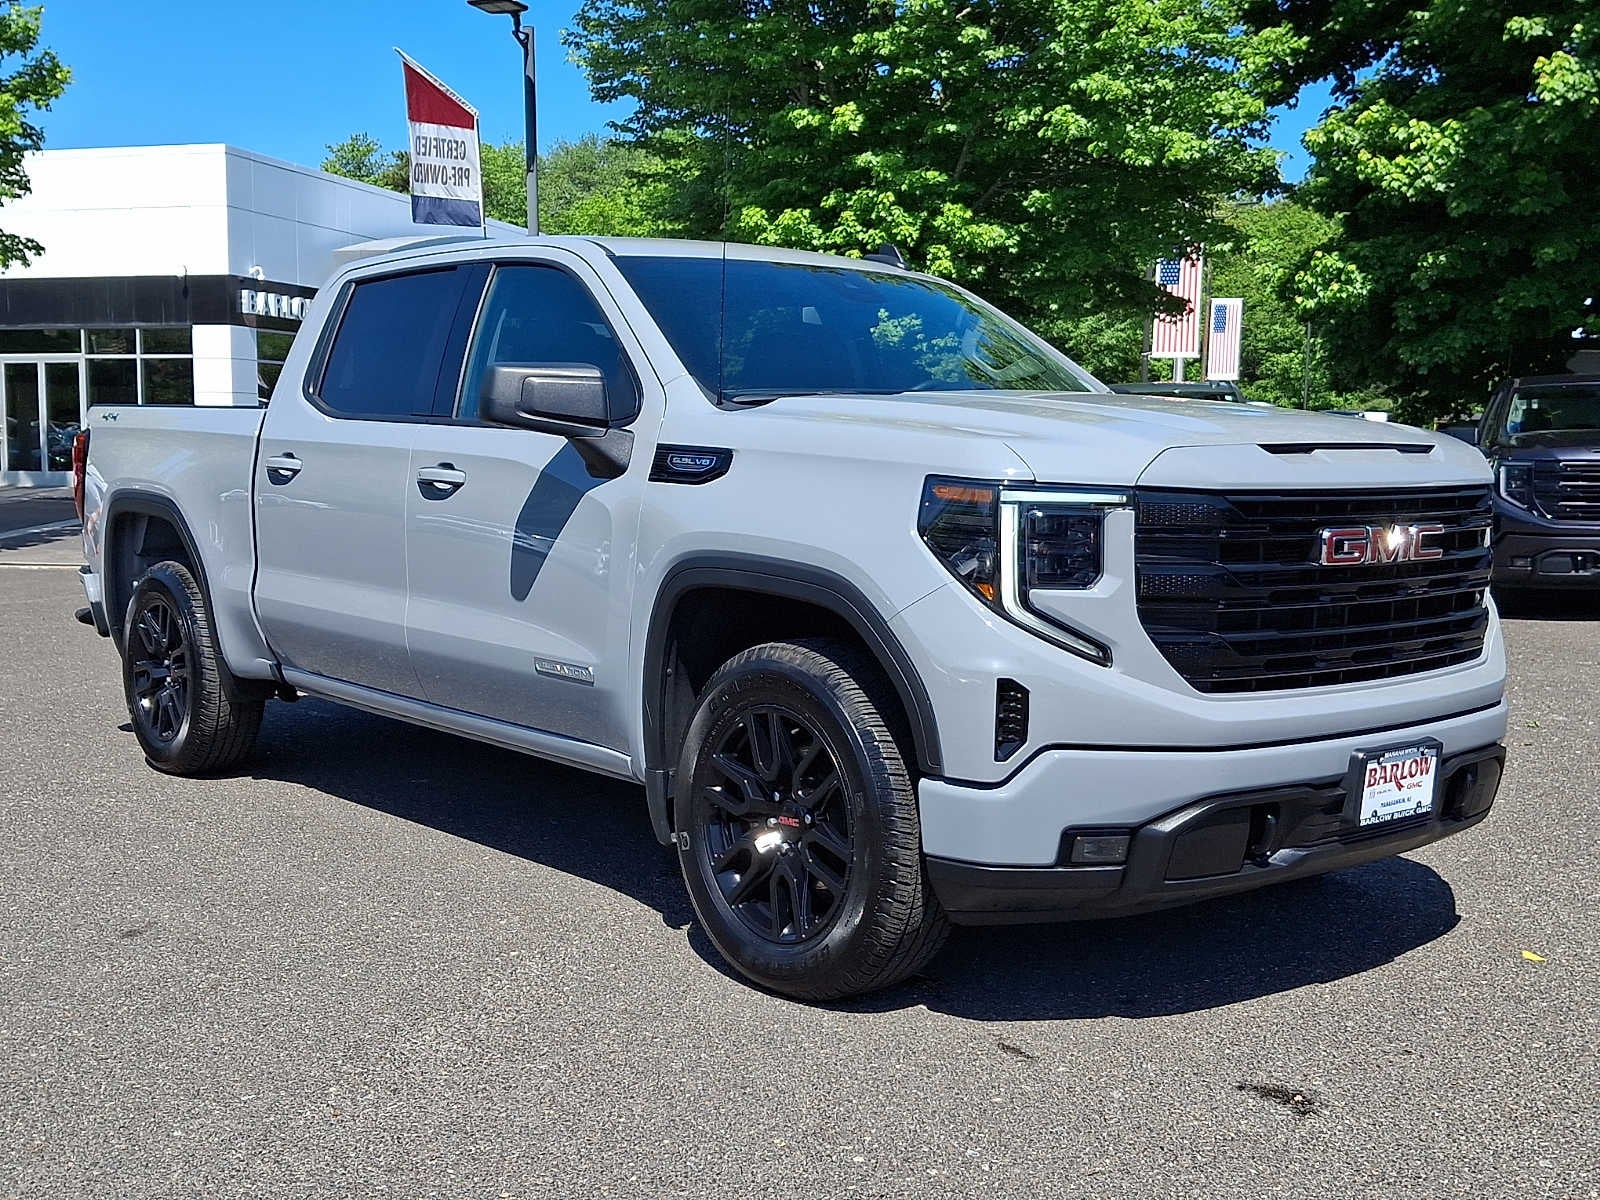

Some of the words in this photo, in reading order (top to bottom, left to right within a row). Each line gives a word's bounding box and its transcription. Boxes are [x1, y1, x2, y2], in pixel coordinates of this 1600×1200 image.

[1320, 524, 1444, 566] GMC
[1366, 755, 1433, 791] BARLOW
[1406, 780, 1423, 790] GMC
[778, 815, 800, 828] GMC
[1360, 812, 1393, 827] BARLOW
[1393, 808, 1415, 820] BUICK
[1415, 804, 1433, 814] GMC
